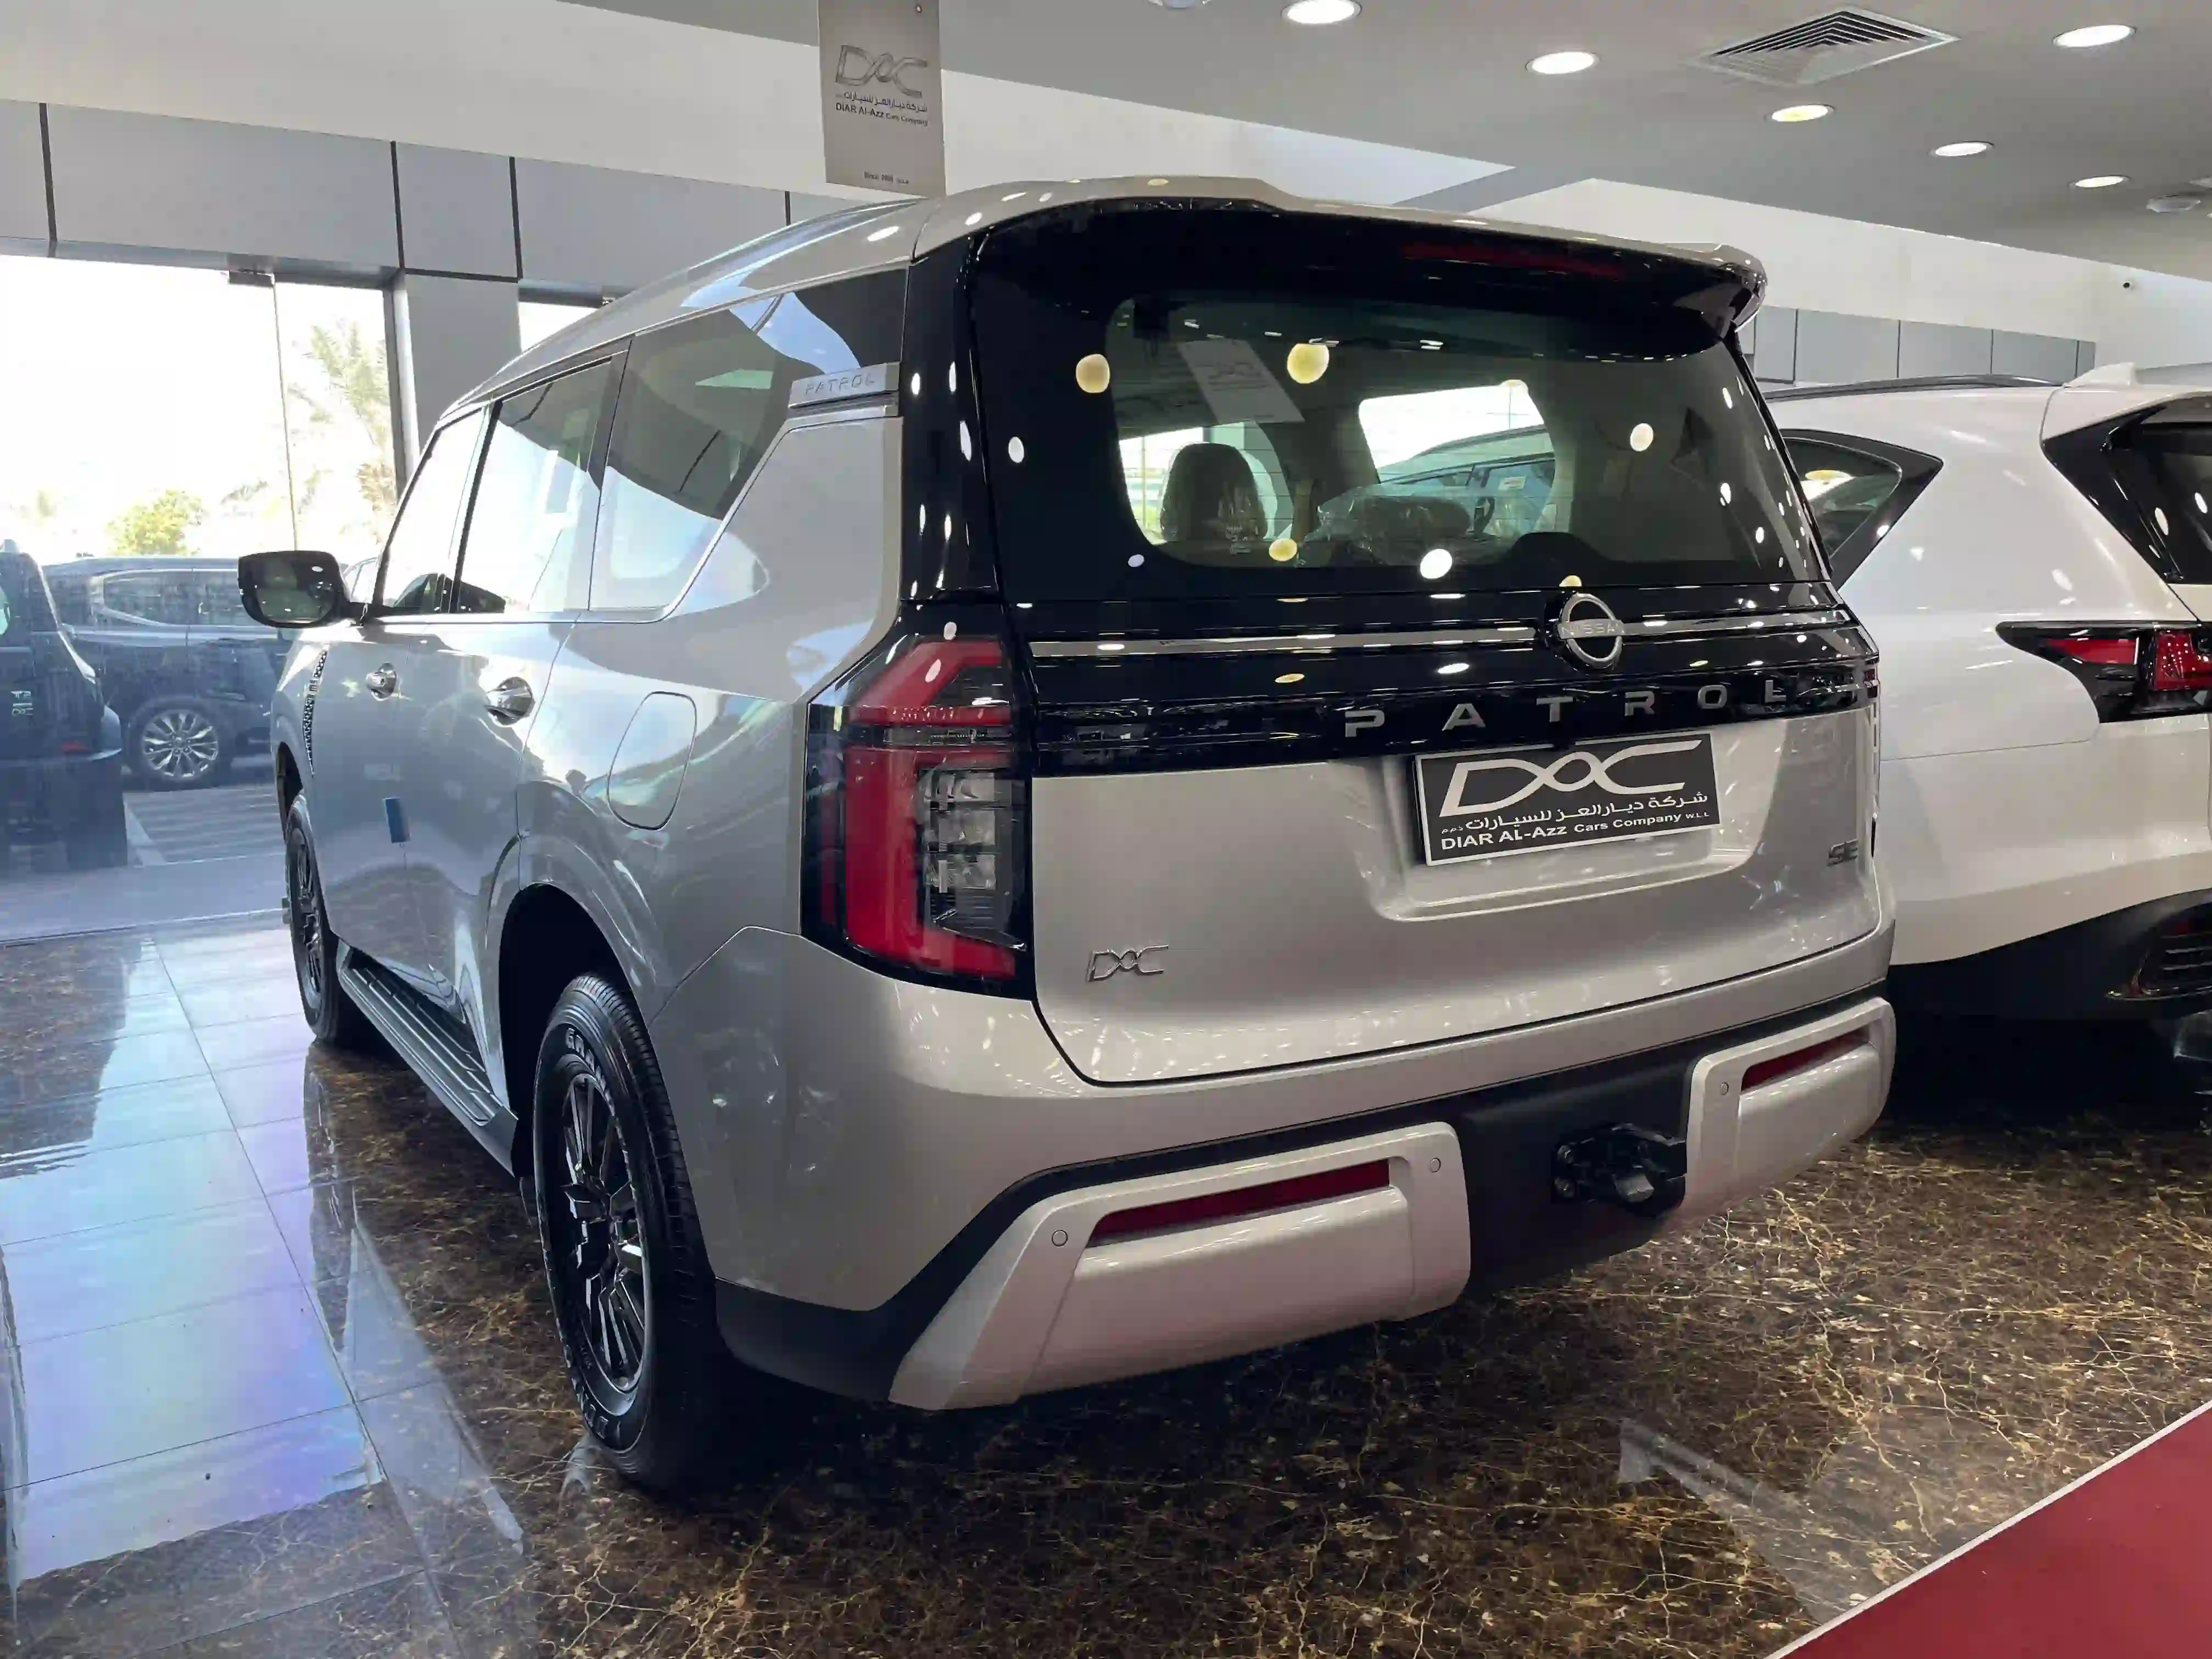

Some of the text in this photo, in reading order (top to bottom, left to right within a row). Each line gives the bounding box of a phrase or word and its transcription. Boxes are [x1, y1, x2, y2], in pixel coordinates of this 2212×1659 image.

[836, 102, 857, 113] DIAR
[805, 374, 876, 395] PATROL
[1344, 679, 1786, 738] PATROL
[1648, 791, 1708, 808] شركة
[1465, 809, 1552, 830] للسيارات
[1441, 833, 1494, 851] DIAR
[1574, 823, 1608, 833] Cars
[1612, 813, 1682, 828] Company
[1826, 838, 1858, 867] SE
